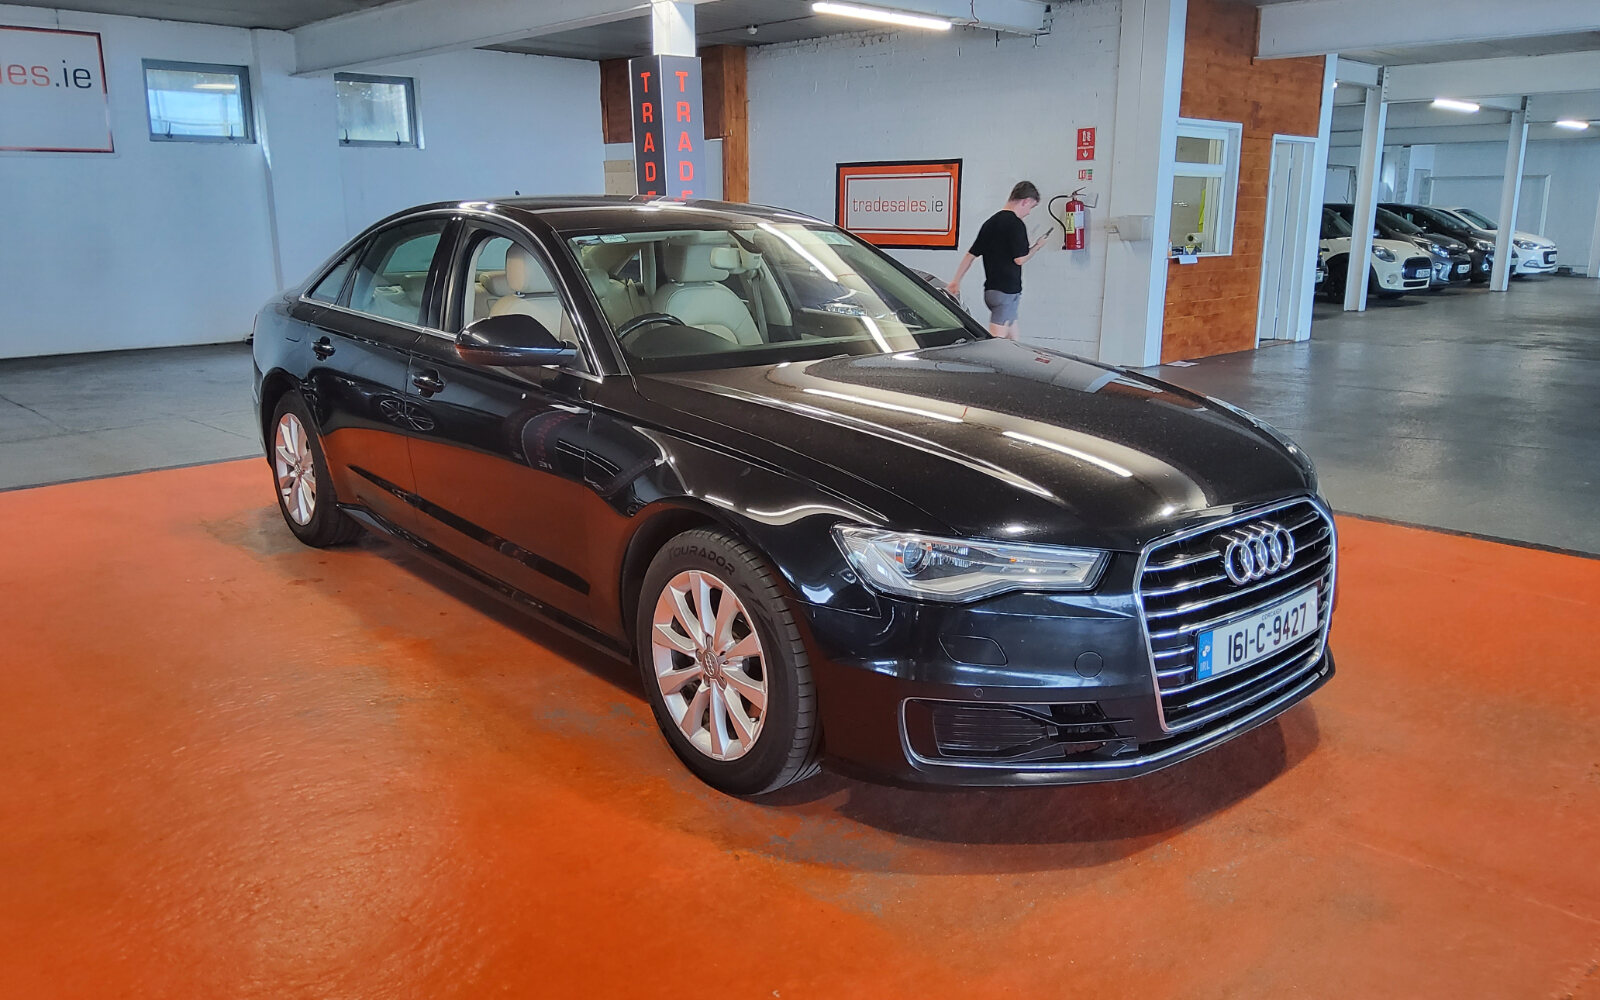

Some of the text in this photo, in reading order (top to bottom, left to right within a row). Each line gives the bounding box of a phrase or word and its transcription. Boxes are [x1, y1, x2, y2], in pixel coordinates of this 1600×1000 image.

[640, 71, 657, 195] TRAD
[852, 195, 944, 213] tradesales.ie
[1227, 602, 1307, 665] 161-C-9427
